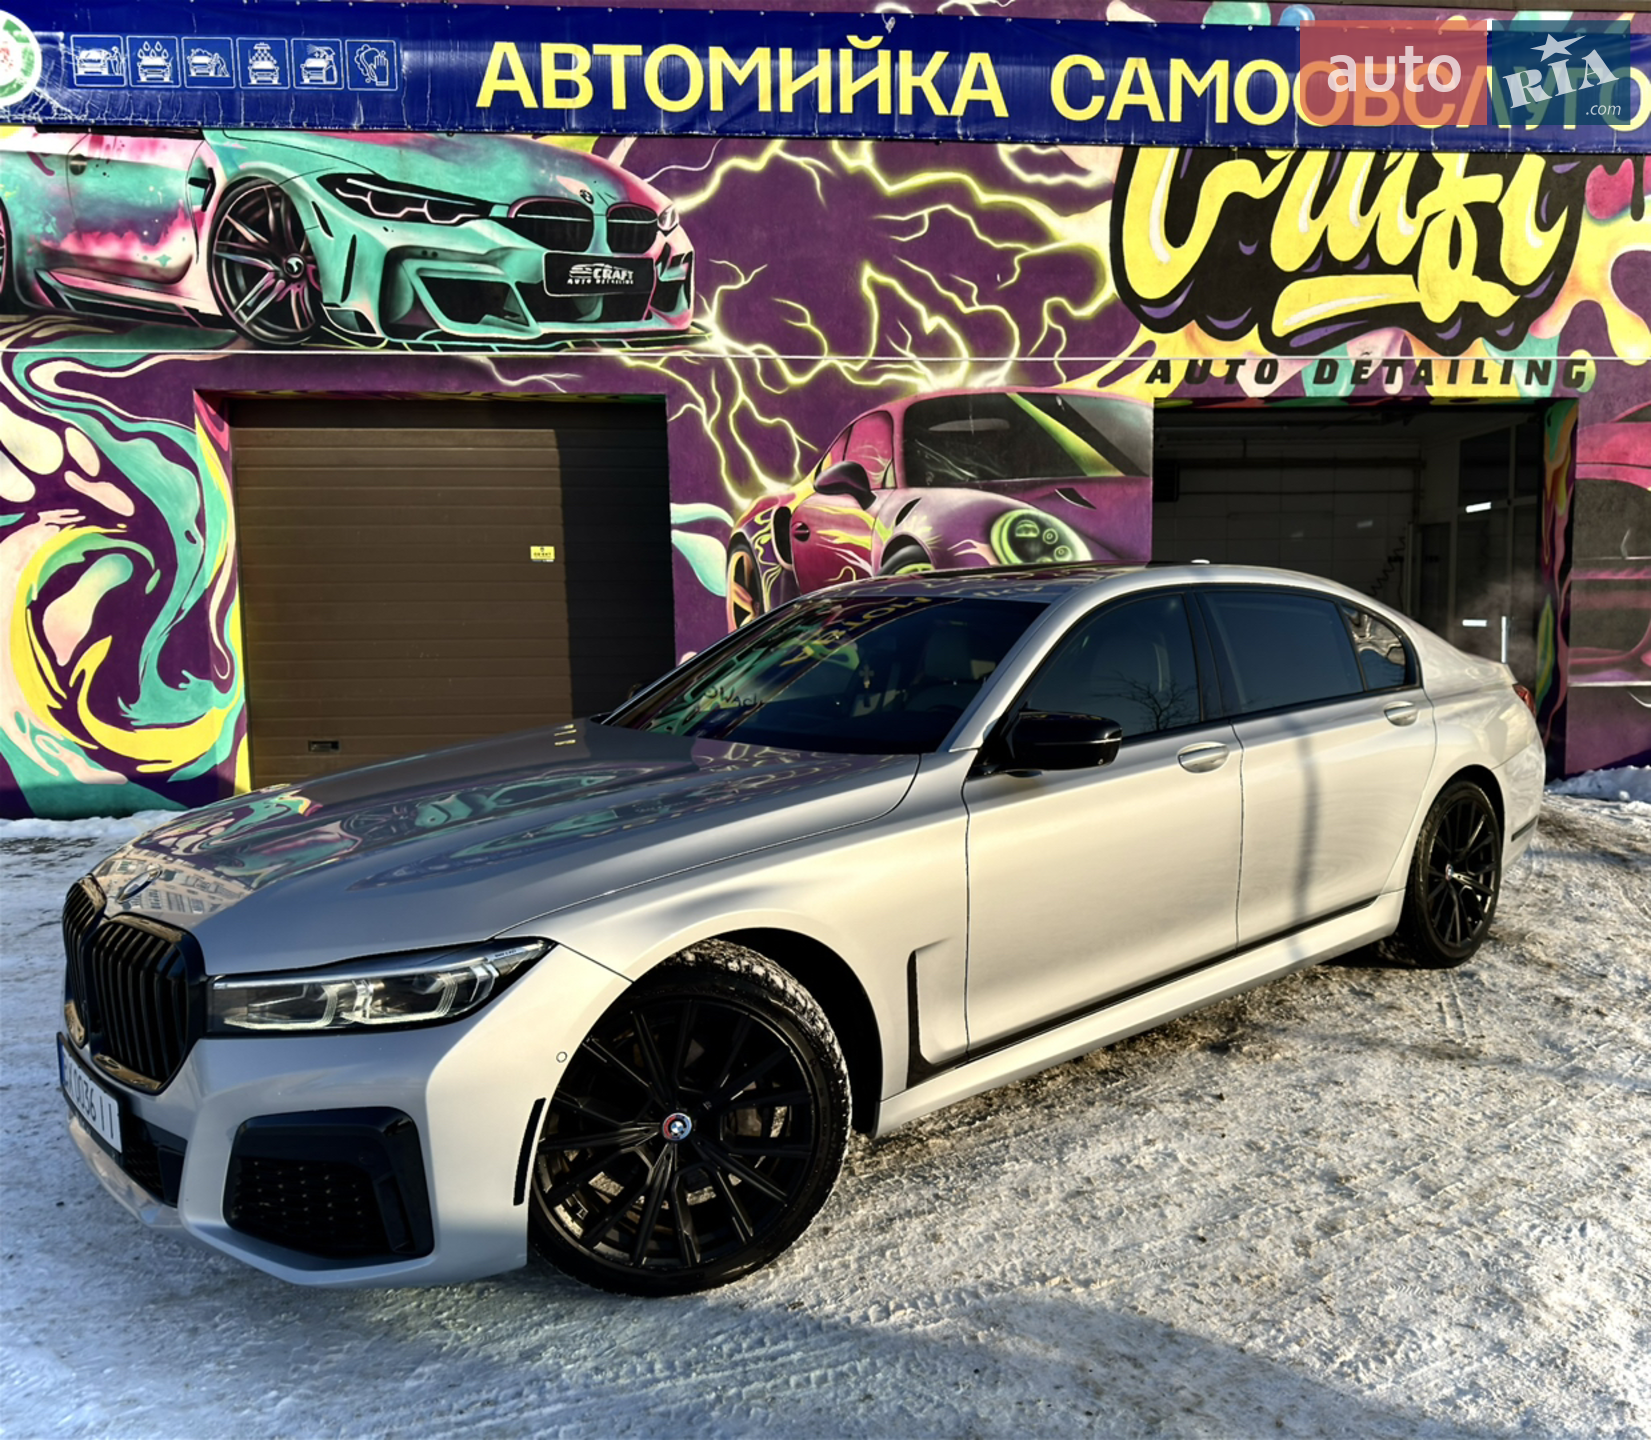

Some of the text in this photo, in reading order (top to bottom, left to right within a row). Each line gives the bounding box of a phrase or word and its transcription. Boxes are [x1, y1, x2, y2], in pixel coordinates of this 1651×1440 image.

[475, 35, 1009, 118] АВТОМИЙКА
[1146, 358, 1589, 390] AUTO DETAILING
